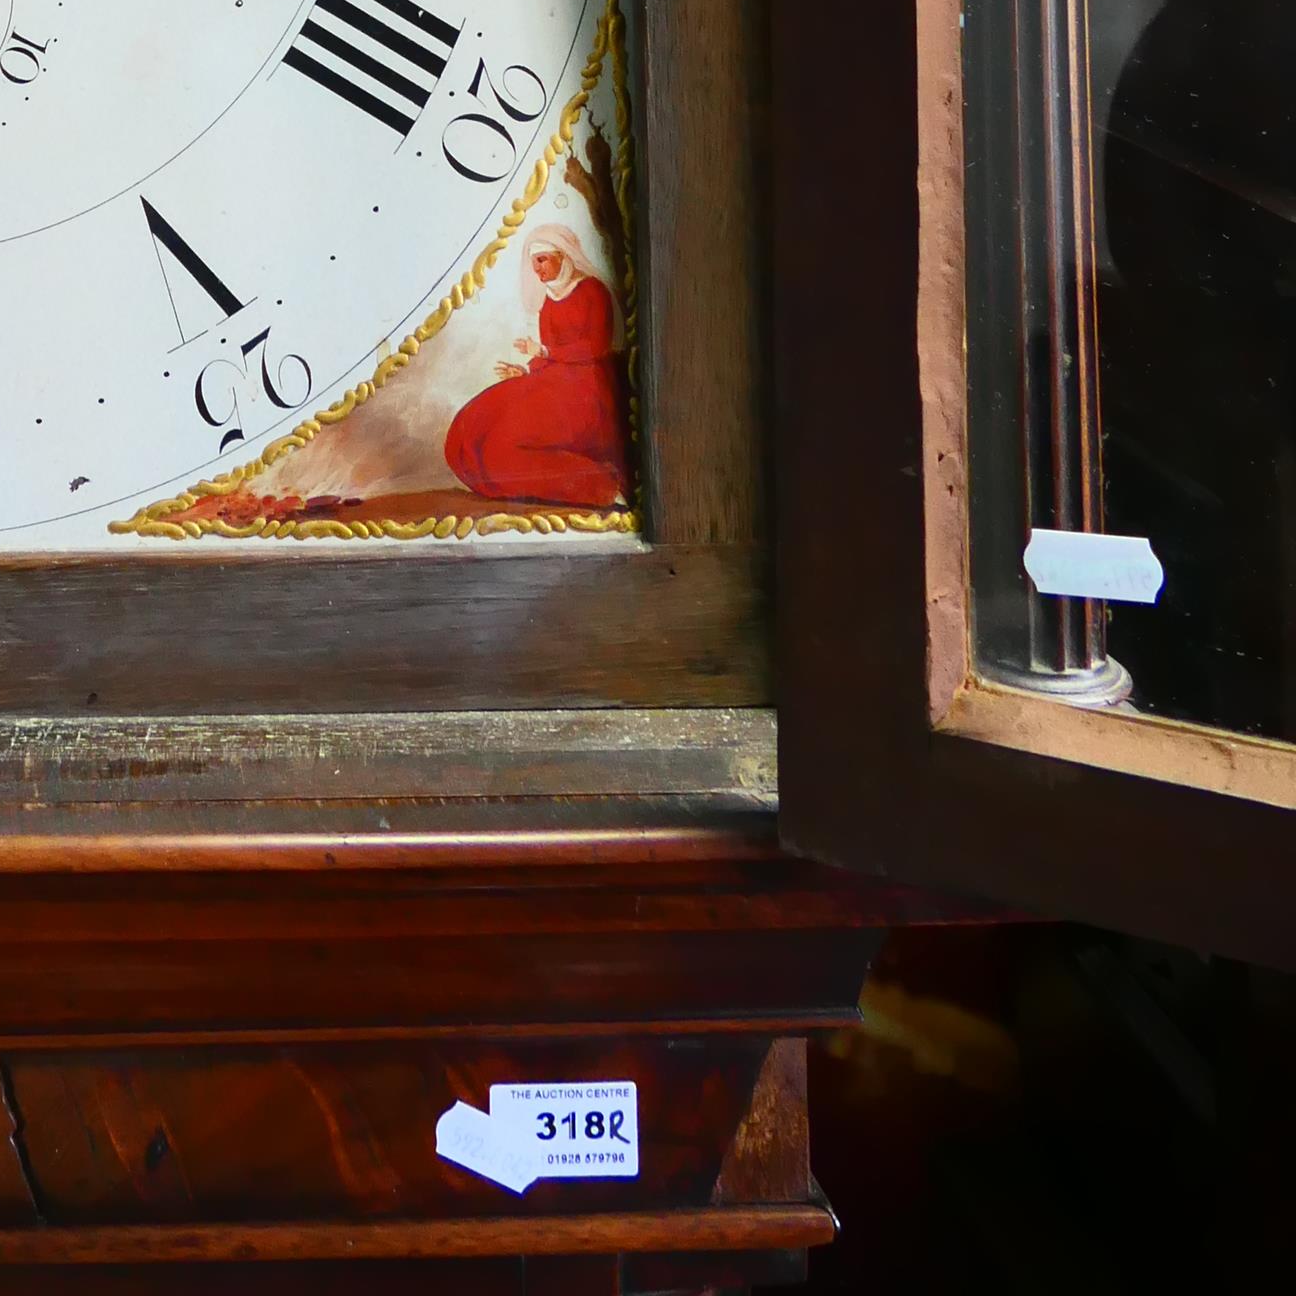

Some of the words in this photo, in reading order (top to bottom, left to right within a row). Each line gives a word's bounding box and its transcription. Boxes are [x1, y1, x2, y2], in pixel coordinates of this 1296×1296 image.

[0, 26, 52, 85] 10
[442, 57, 547, 183] 20
[141, 194, 258, 354] V
[194, 326, 312, 455] 25
[511, 1089, 532, 1100] THE
[534, 1089, 583, 1100] AUCTION
[586, 1087, 631, 1099] CENTRE
